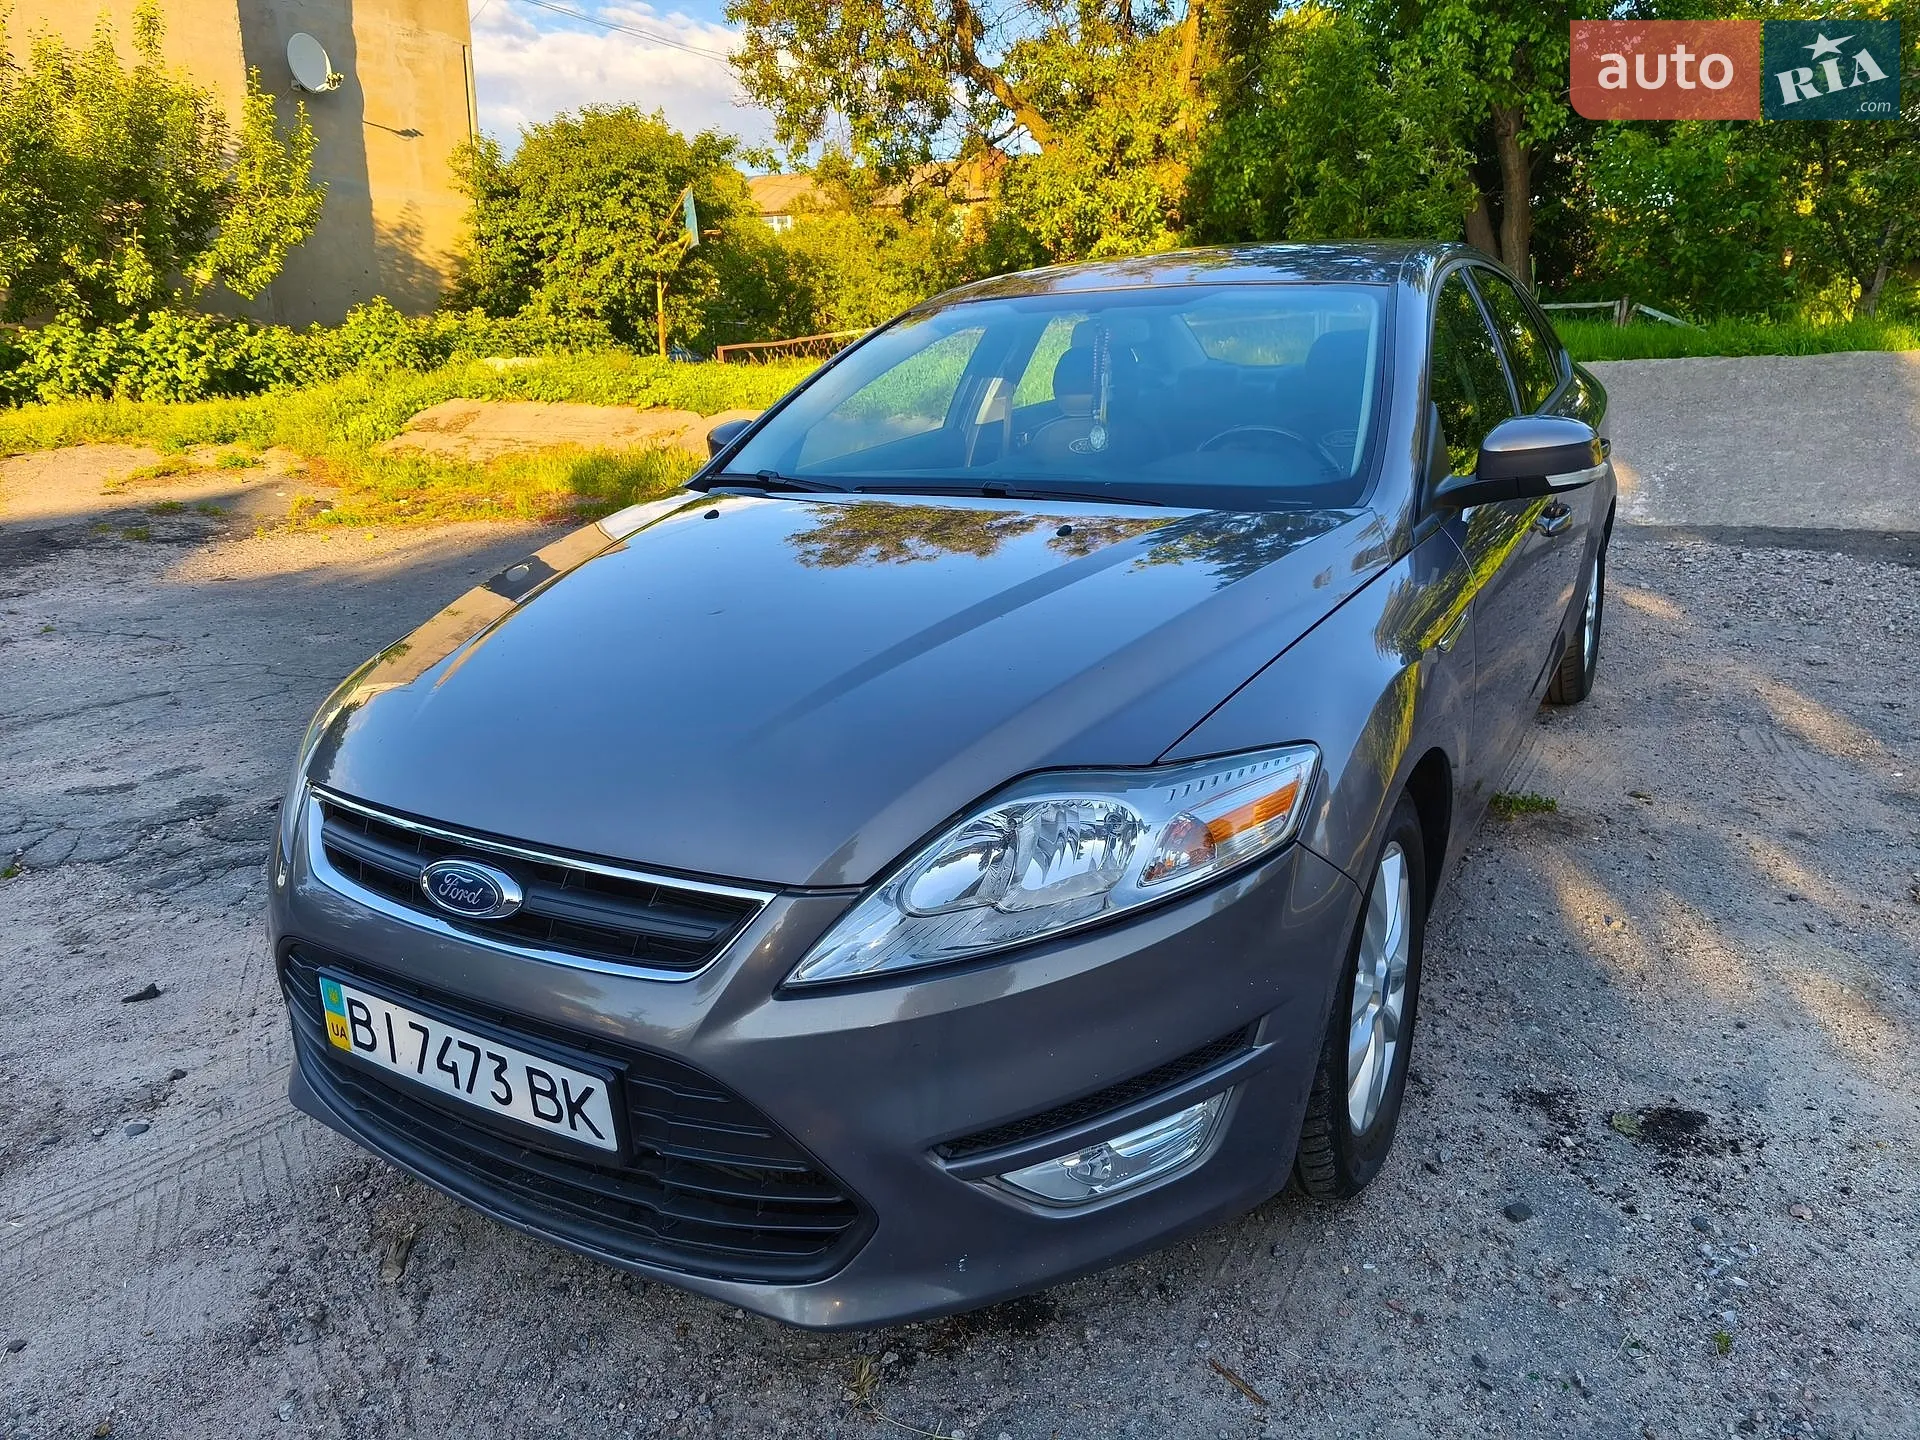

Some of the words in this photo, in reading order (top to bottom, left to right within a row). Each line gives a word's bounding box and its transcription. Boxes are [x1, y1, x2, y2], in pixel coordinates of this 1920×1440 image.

[438, 872, 484, 905] Ford
[330, 1022, 348, 1041] UA
[346, 996, 397, 1064] BI
[408, 1020, 513, 1106] 7473
[525, 1065, 605, 1140] BK
